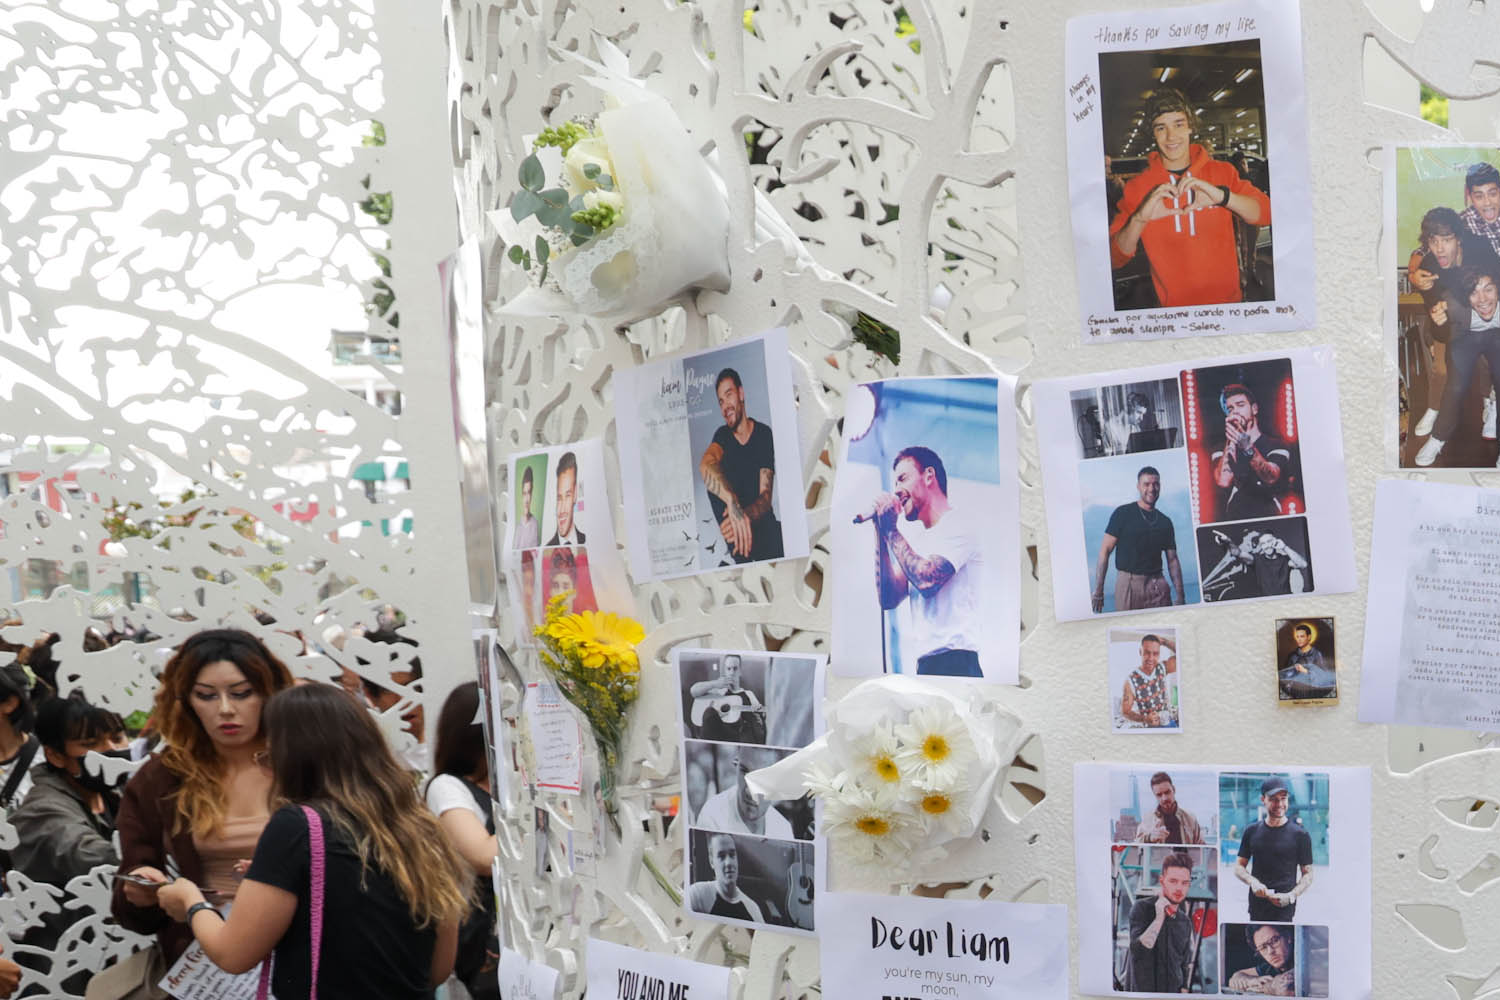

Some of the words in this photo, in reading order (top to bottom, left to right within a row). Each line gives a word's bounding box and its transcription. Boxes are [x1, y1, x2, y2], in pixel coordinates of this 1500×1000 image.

[1144, 27, 1161, 43] for
[1215, 22, 1231, 37] my
[1229, 308, 1240, 316] no
[871, 916, 938, 956] Dear
[946, 921, 1010, 964] Liam
[884, 967, 922, 979] you're
[925, 970, 944, 983] my
[946, 972, 971, 984] sun,
[974, 975, 995, 987] my
[921, 983, 959, 997] moon,
